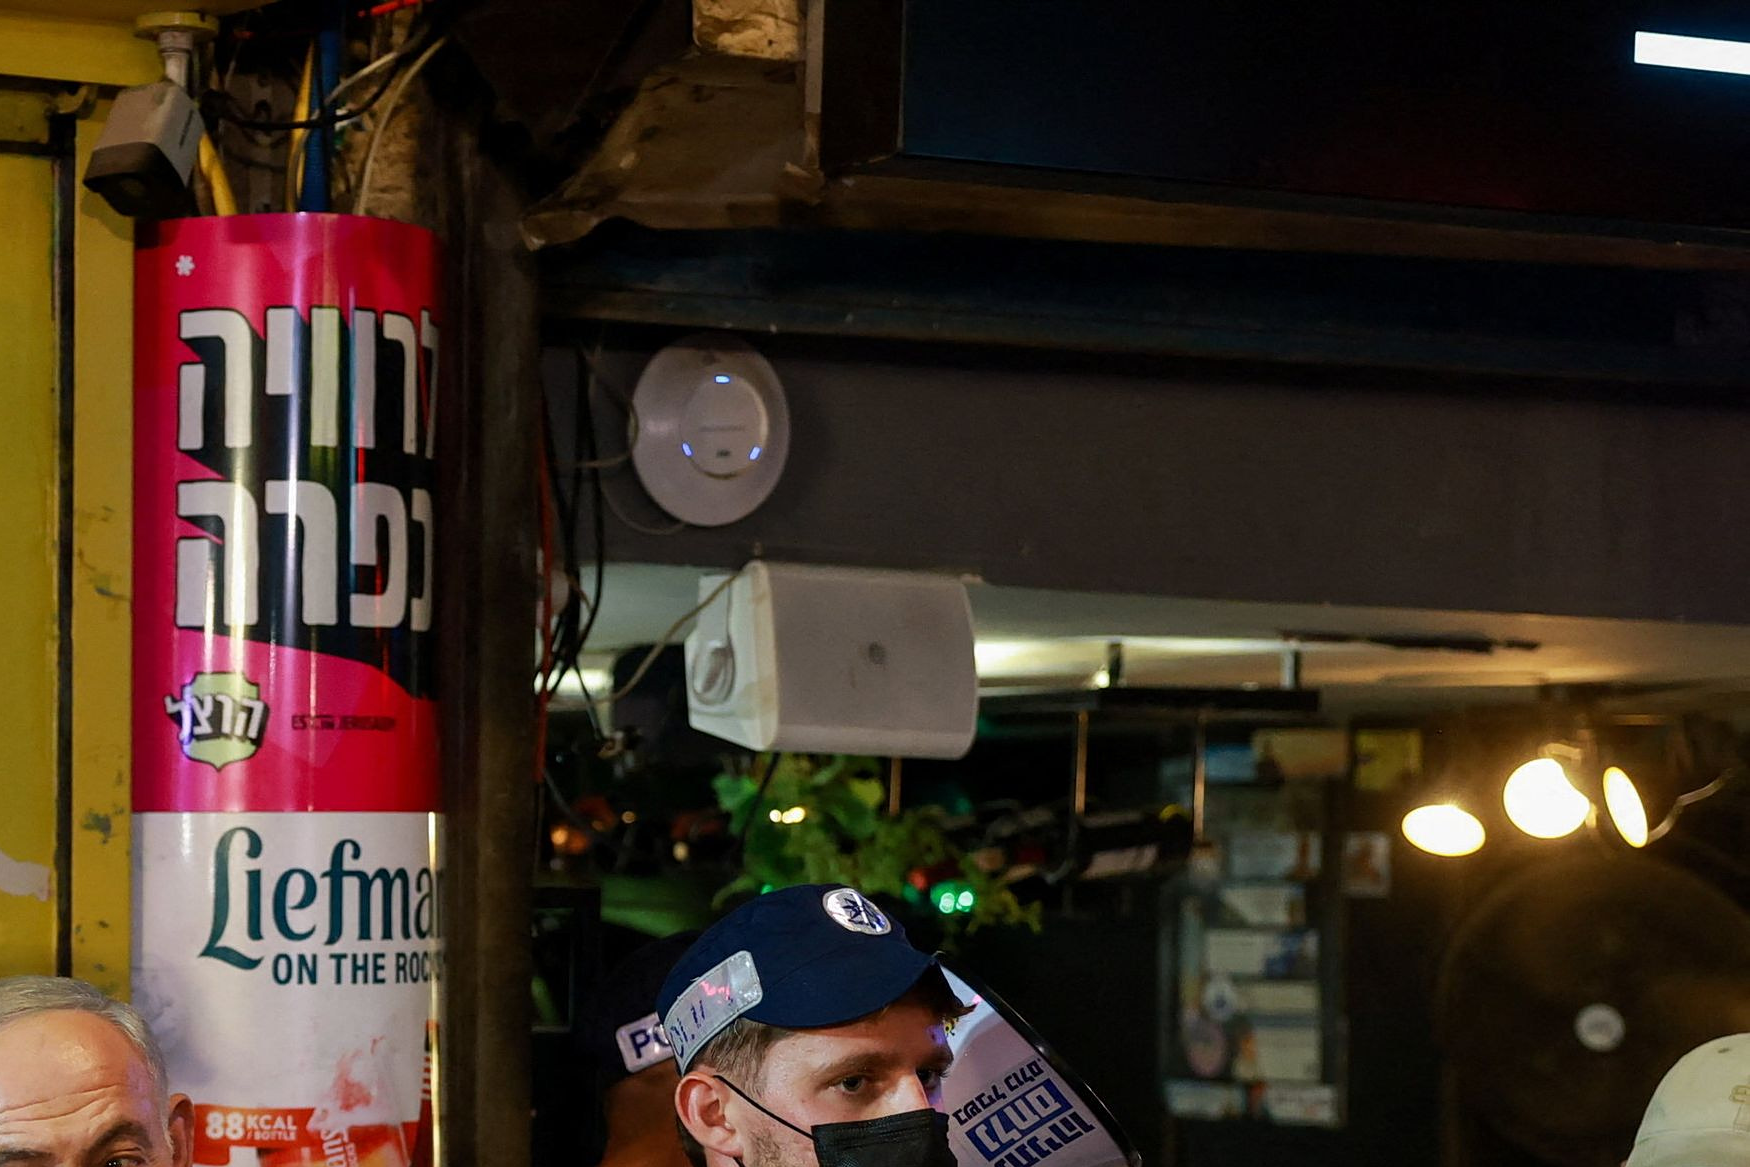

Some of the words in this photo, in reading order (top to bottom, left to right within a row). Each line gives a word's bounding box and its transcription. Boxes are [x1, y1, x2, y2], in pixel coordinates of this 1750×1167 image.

[164, 694, 264, 742] הרצל
[272, 952, 318, 985] ON
[329, 953, 386, 985] THE
[395, 952, 444, 984] ROC
[206, 1111, 244, 1140] 88
[246, 1113, 297, 1131] KCAL
[952, 1084, 1007, 1126] בשביל
[973, 1083, 1058, 1154] נלחם
